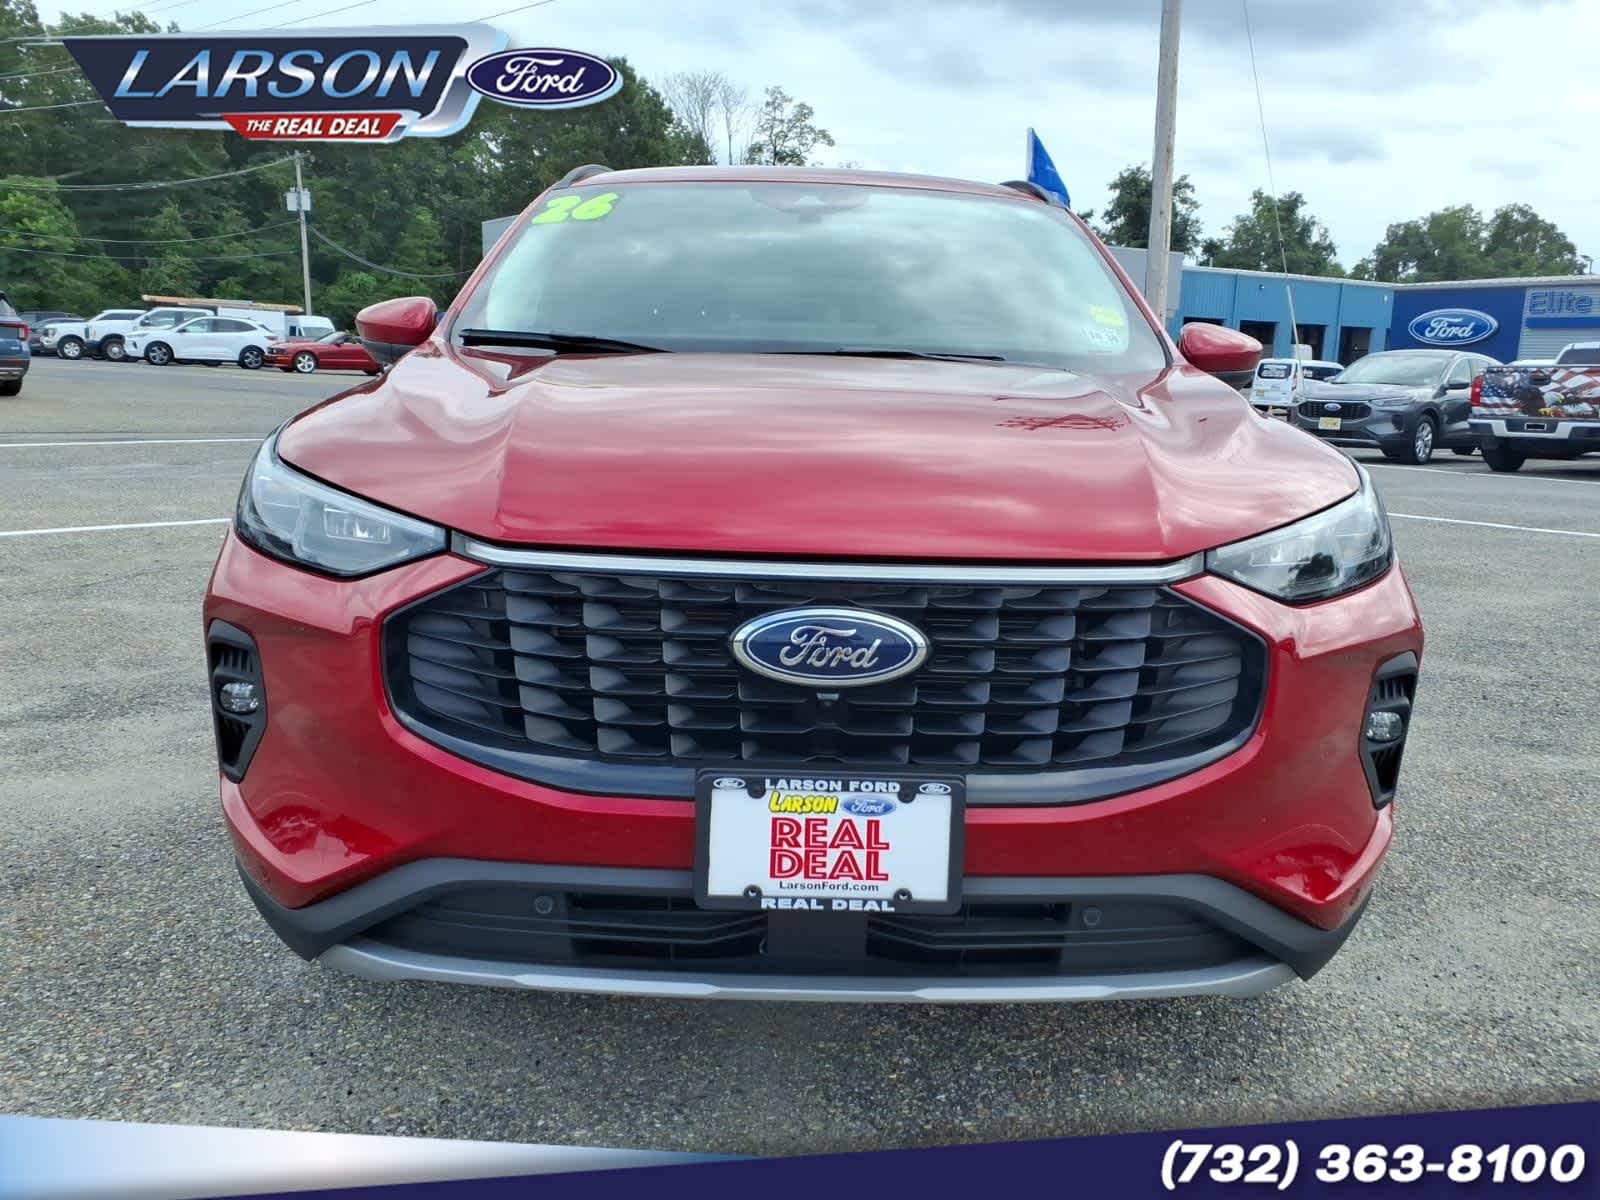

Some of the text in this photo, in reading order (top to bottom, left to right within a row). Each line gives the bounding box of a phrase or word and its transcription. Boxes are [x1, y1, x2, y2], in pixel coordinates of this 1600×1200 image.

[531, 192, 619, 224] 26
[1529, 291, 1593, 315] Elite
[1424, 316, 1475, 338] Ford
[778, 624, 882, 669] Ford
[765, 779, 900, 793] LARSON FORD
[769, 791, 885, 815] LARSON Ford
[770, 816, 889, 850] REAL
[769, 848, 889, 881] DEAL
[779, 880, 879, 892] LarsonFord.com
[761, 897, 895, 911] REAL DEAL
